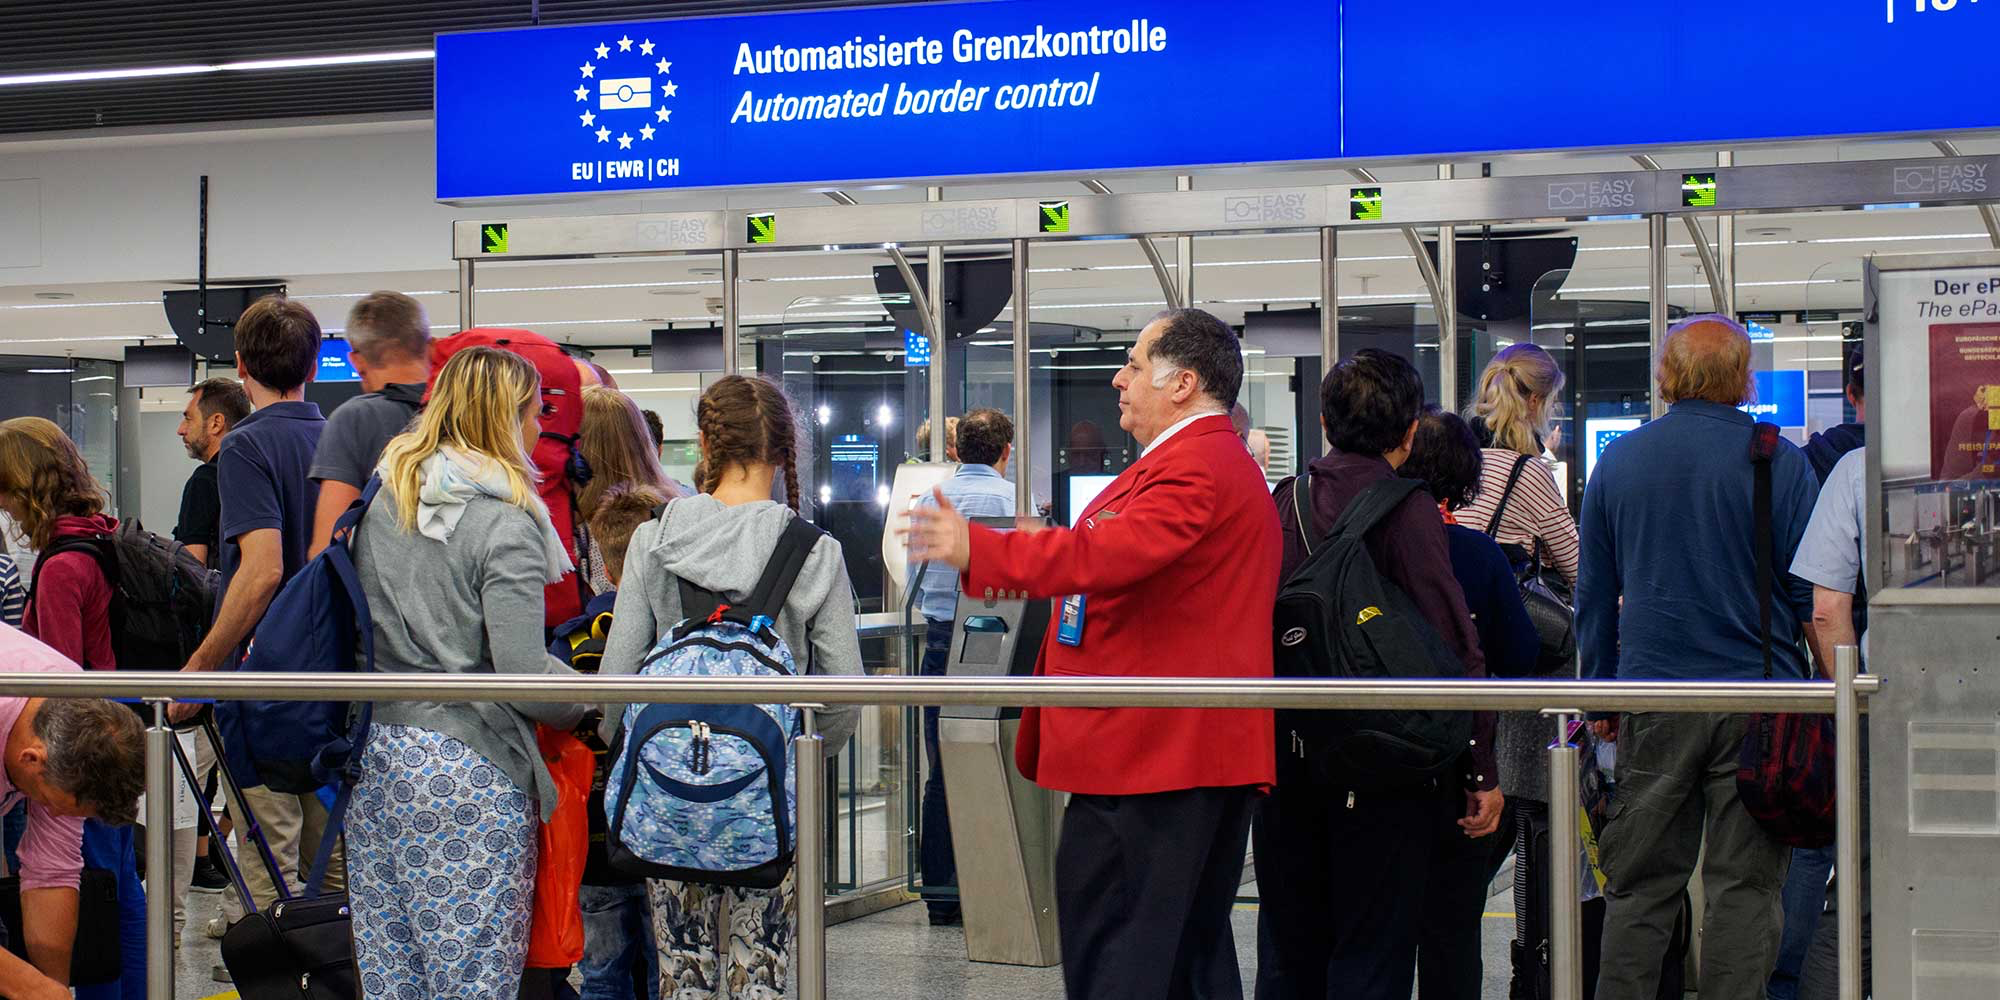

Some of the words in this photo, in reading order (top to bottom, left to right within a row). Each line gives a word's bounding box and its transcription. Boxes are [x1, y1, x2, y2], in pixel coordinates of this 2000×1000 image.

[732, 29, 943, 75] Automatisierte
[952, 18, 1167, 63] Grenzkontrolle
[730, 83, 890, 124] Automated
[893, 79, 990, 116] border
[994, 71, 1100, 111] control
[572, 161, 594, 180] EU
[606, 159, 644, 178] EWR
[656, 158, 679, 177] CH
[1938, 164, 1988, 178] EASY
[1590, 179, 1635, 194] EASY
[1938, 178, 1987, 193] PASS
[1263, 193, 1306, 208] EASY
[1590, 193, 1635, 208] PASS
[1263, 207, 1306, 221] PASS
[670, 218, 706, 232] EASY
[670, 230, 706, 243] PASS
[1934, 279, 1970, 295] Der
[1917, 301, 1952, 318] The
[1959, 299, 2000, 317] ePa
